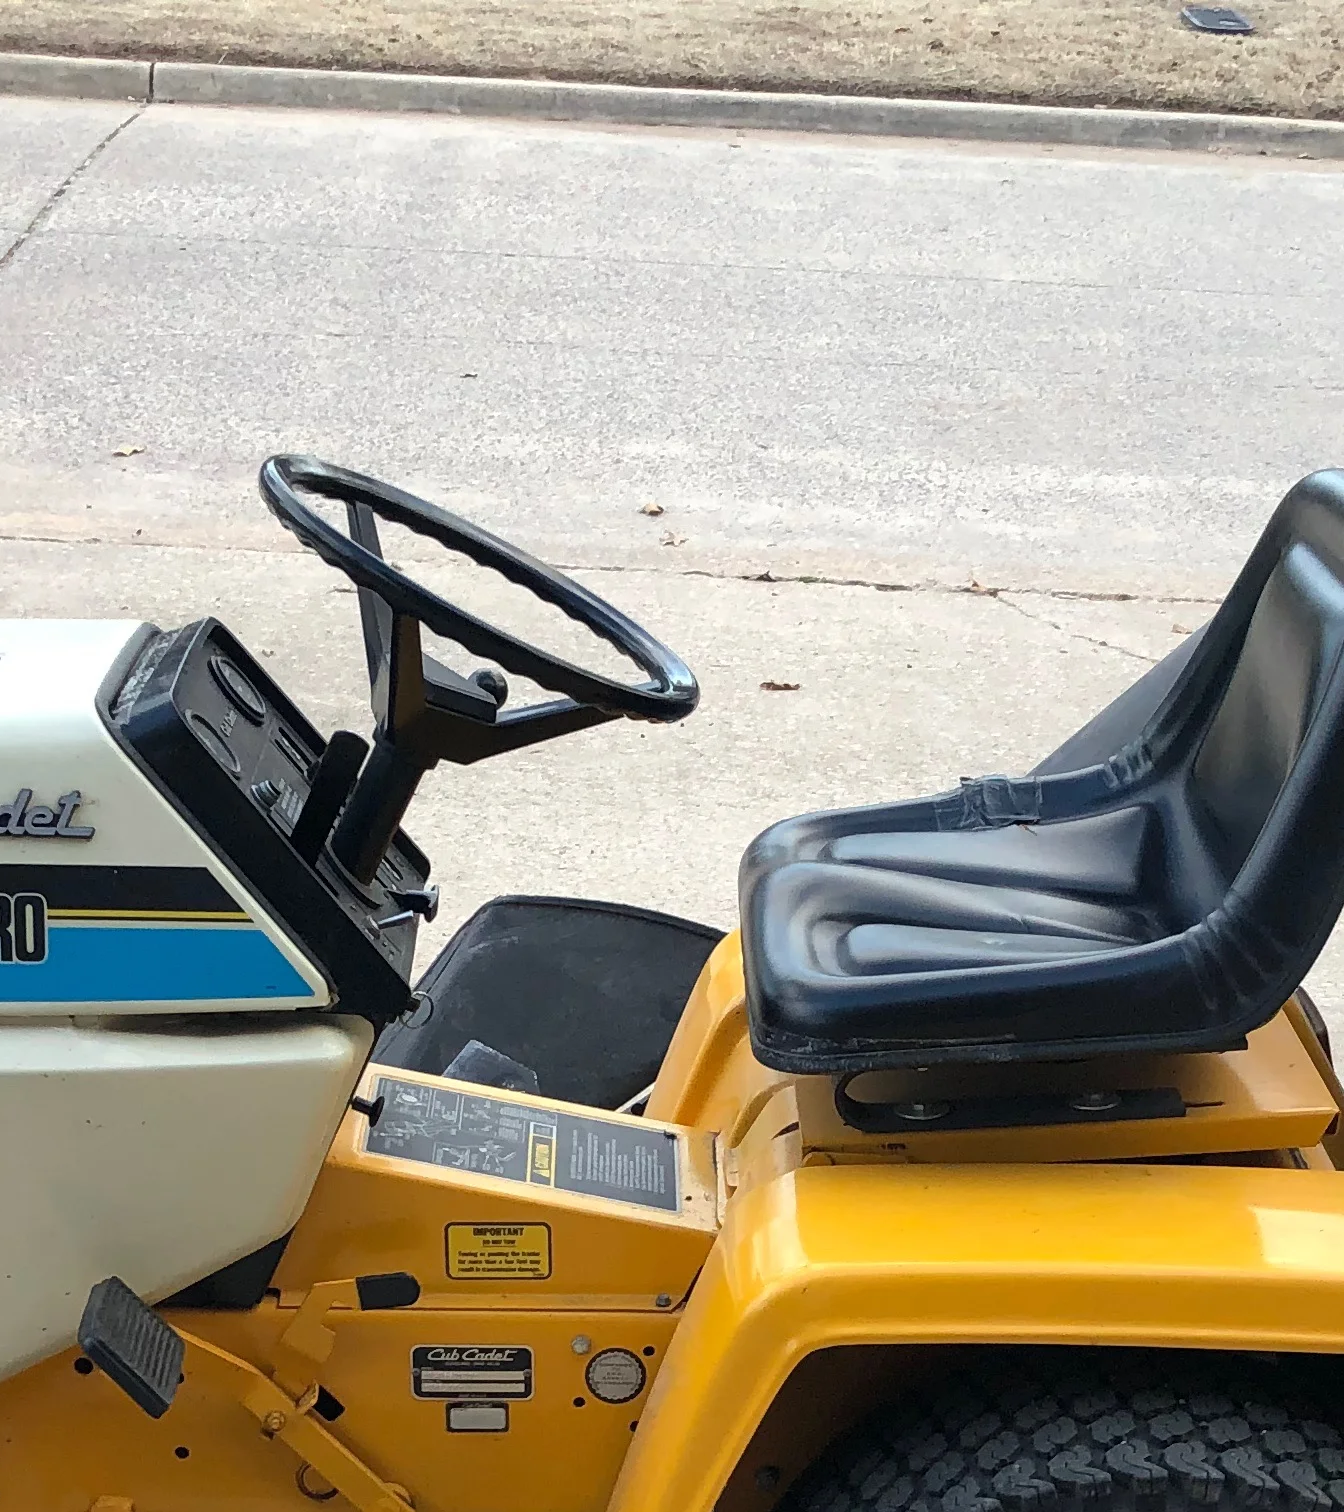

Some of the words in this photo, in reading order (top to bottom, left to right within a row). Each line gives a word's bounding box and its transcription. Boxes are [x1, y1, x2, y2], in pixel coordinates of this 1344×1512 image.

[472, 1228, 524, 1236] IMPORTANT
[427, 1348, 459, 1361] Cub
[461, 1348, 517, 1362] Cadet
